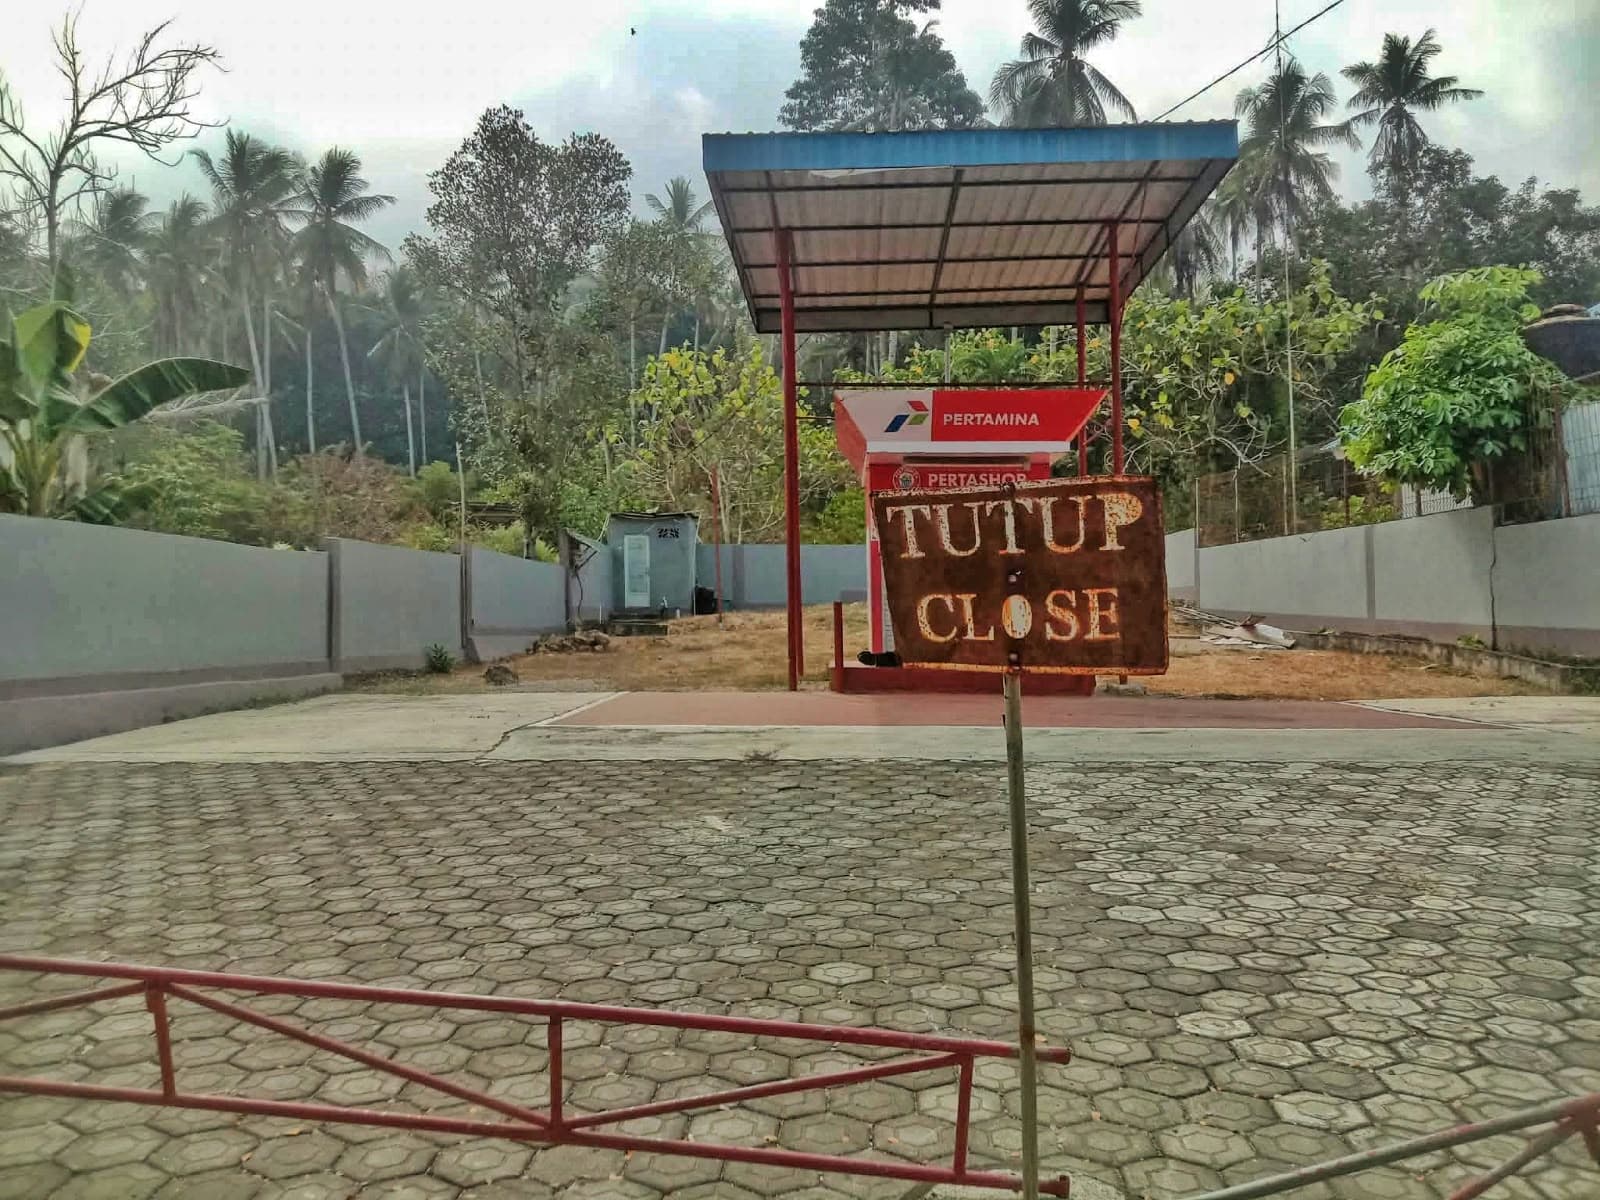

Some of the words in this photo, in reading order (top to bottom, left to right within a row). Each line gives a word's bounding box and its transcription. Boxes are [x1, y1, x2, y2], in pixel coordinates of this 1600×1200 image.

[943, 412, 1040, 427] PERTAMINA
[886, 492, 1143, 558] TUTUP
[916, 588, 1121, 643] CLOSE
